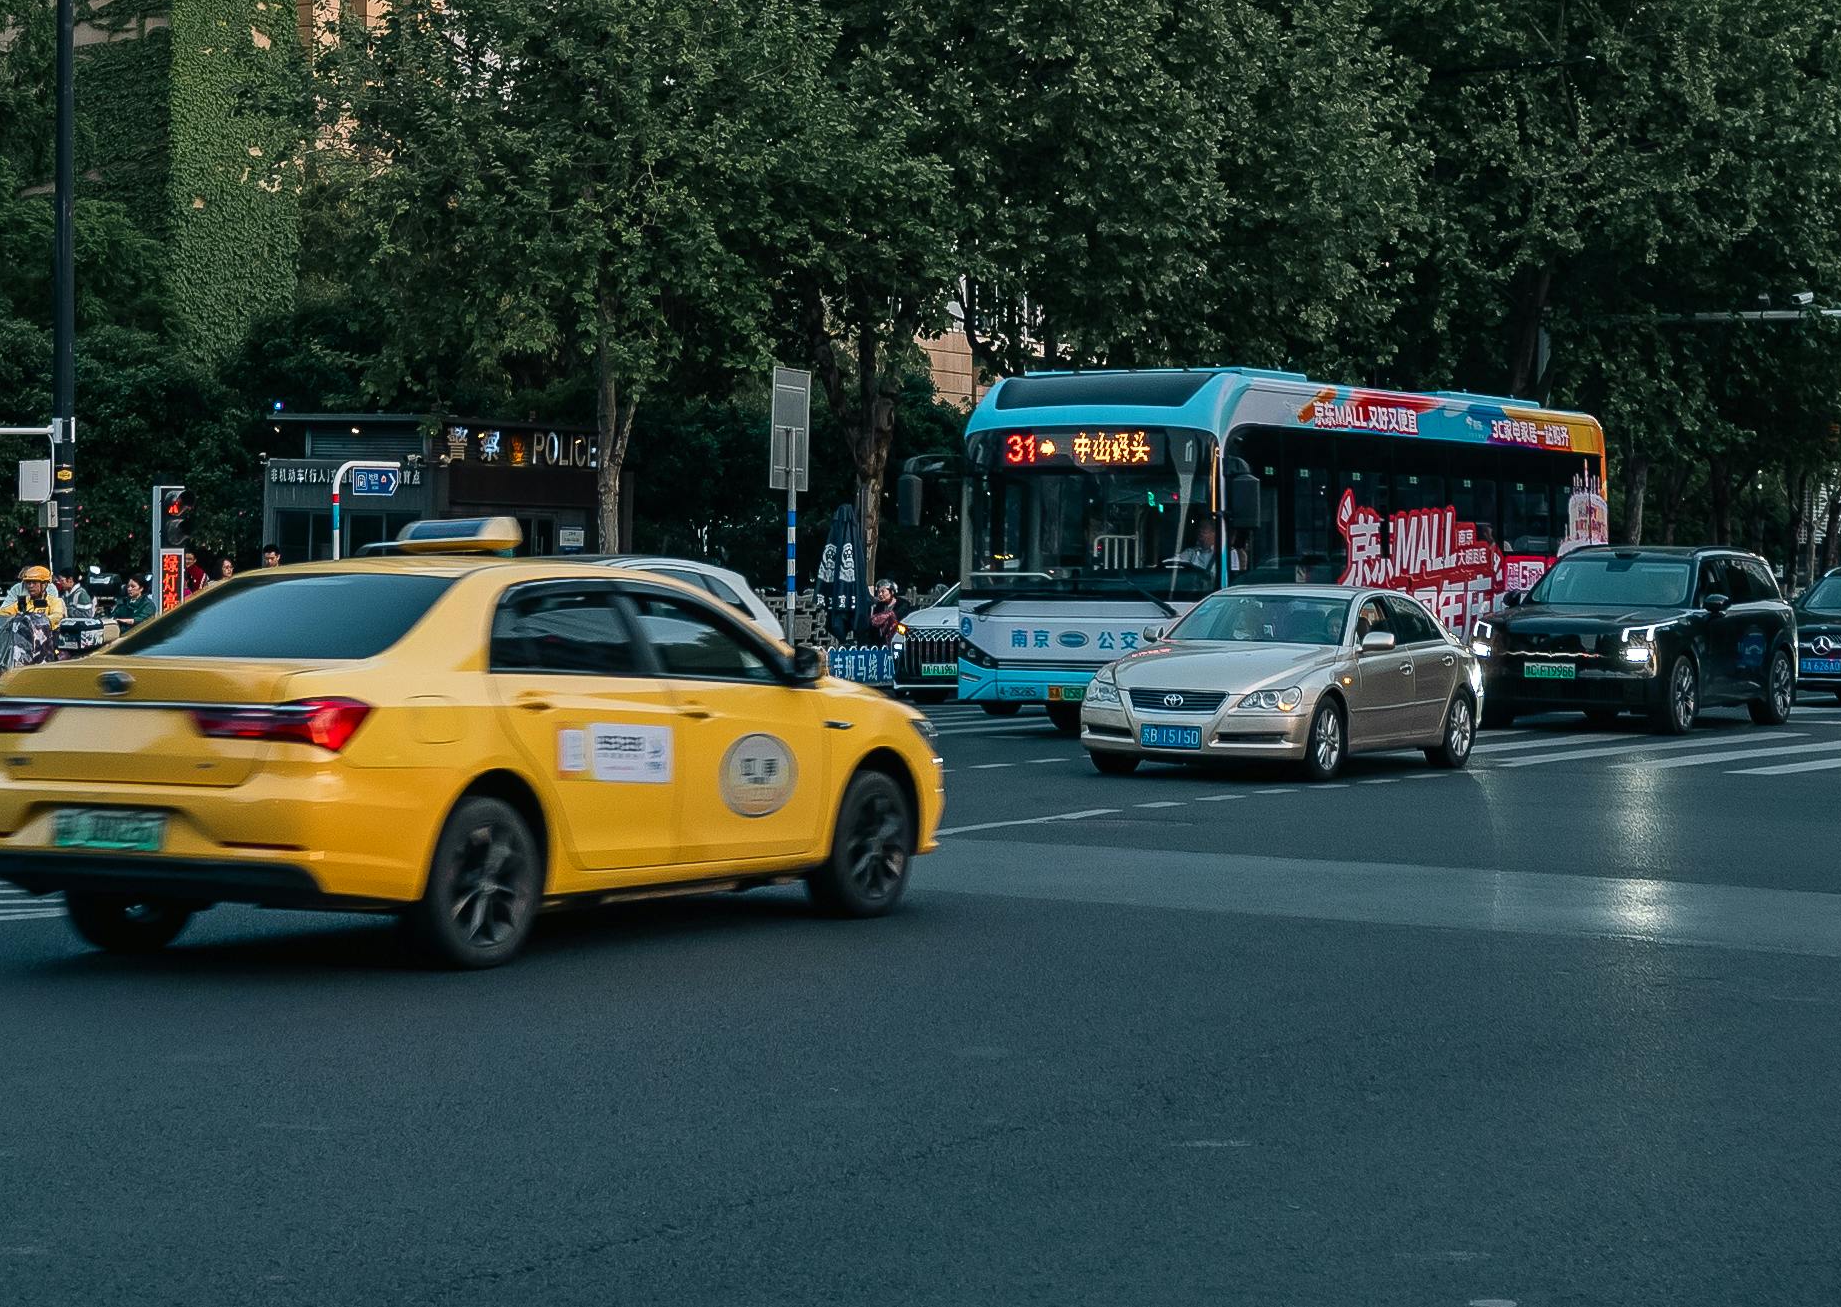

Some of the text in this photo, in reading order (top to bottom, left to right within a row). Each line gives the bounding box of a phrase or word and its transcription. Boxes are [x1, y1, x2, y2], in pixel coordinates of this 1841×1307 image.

[533, 431, 598, 467] POLICE
[1007, 432, 1151, 463] 31 中山码头
[1011, 629, 1139, 650] 南京 公交
